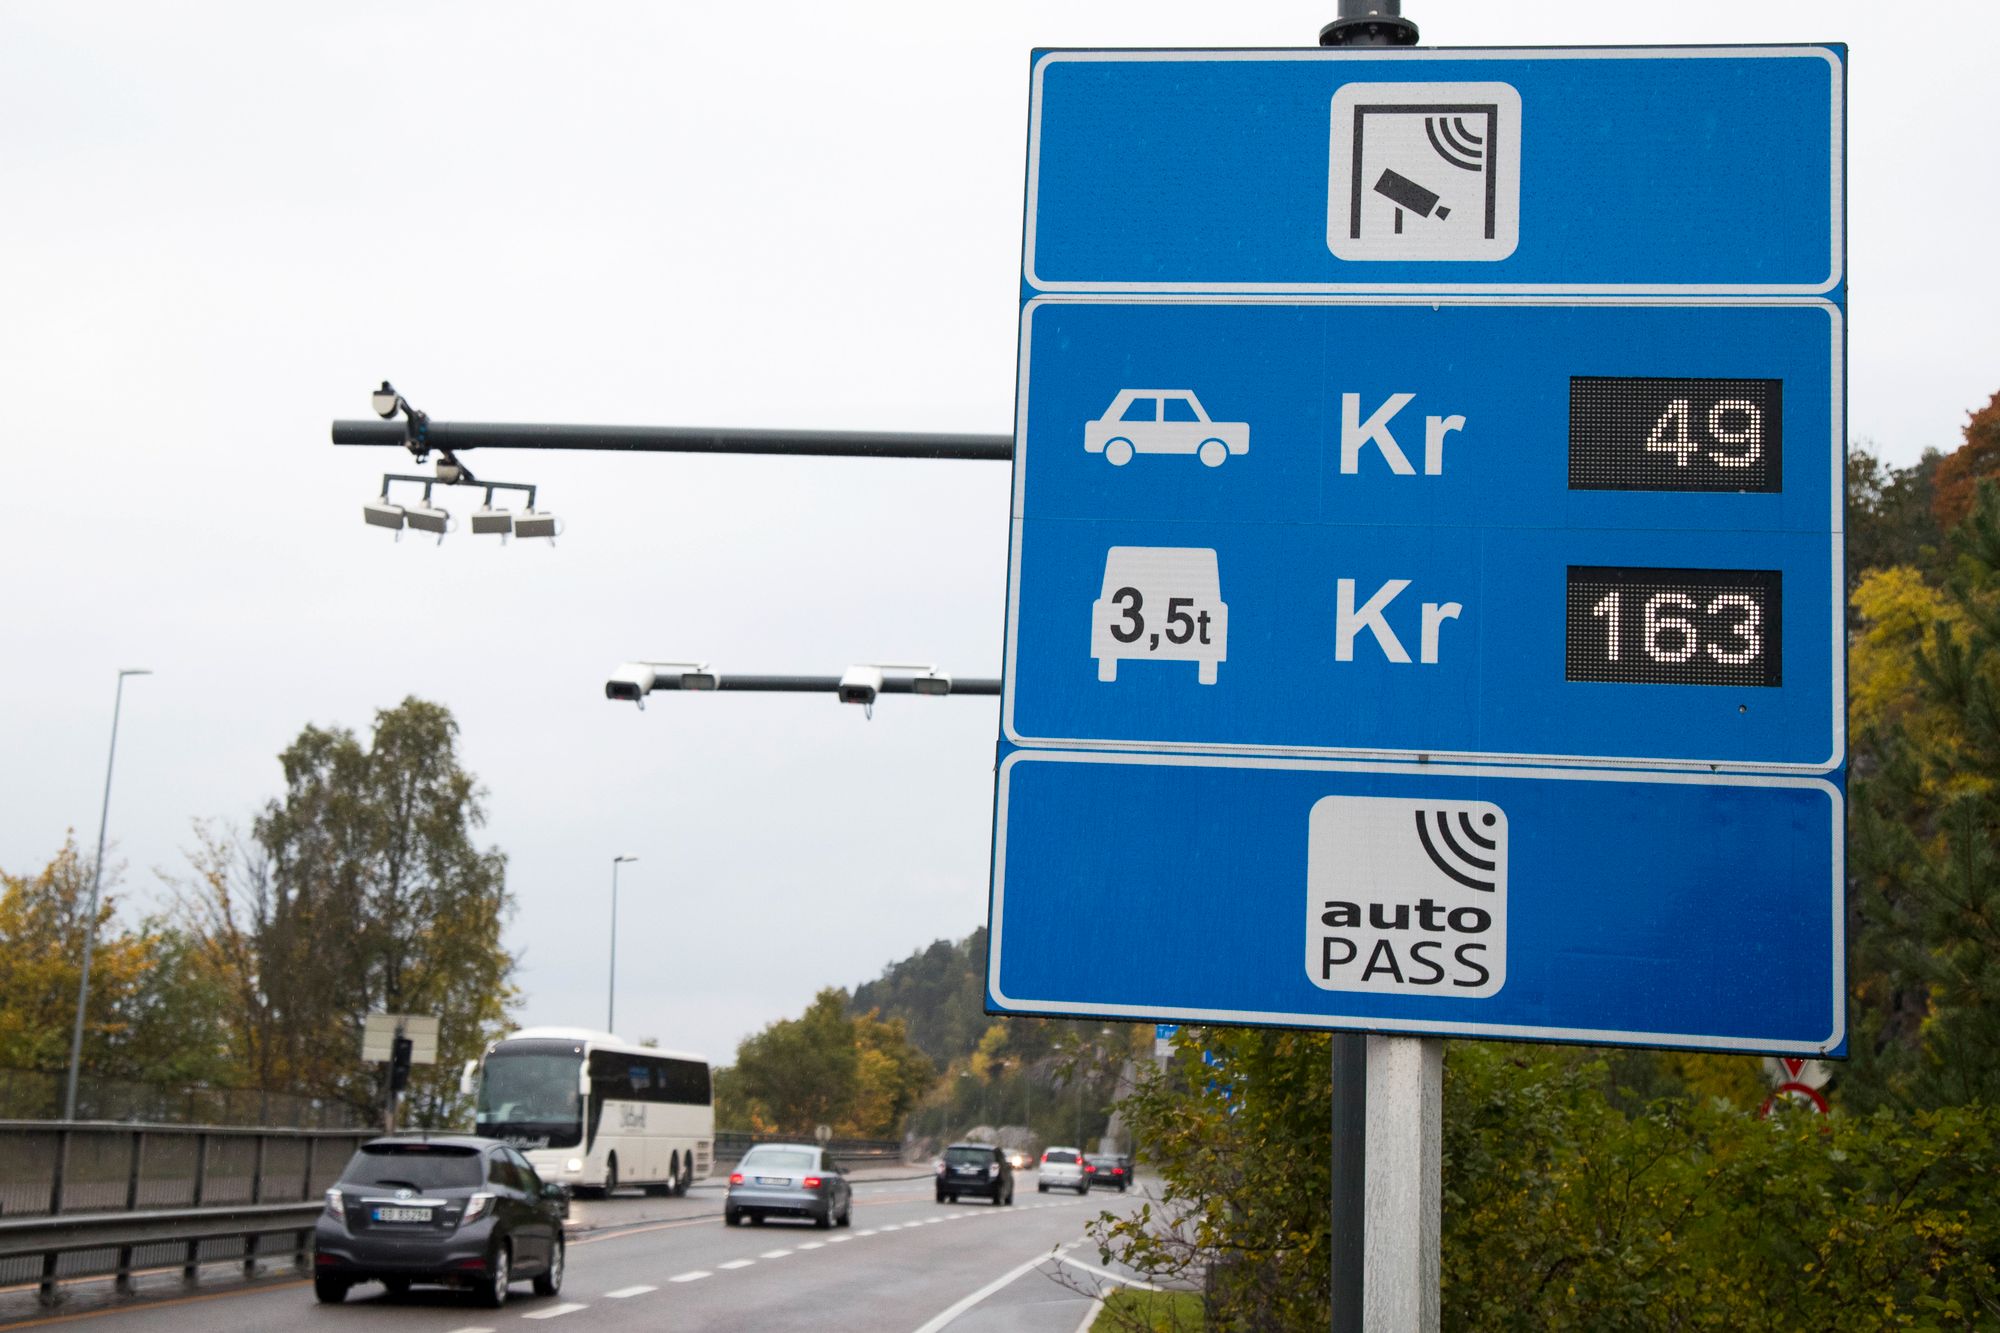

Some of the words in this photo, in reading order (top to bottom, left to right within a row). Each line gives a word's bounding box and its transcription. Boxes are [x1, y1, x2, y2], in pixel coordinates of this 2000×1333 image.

[1340, 392, 1466, 475] Kr
[1646, 398, 1762, 468] 49
[1110, 586, 1211, 651] 3,5t
[1335, 578, 1462, 664] Kr
[1593, 591, 1760, 665] 163
[1321, 898, 1492, 934] auto
[1322, 936, 1490, 988] PASS
